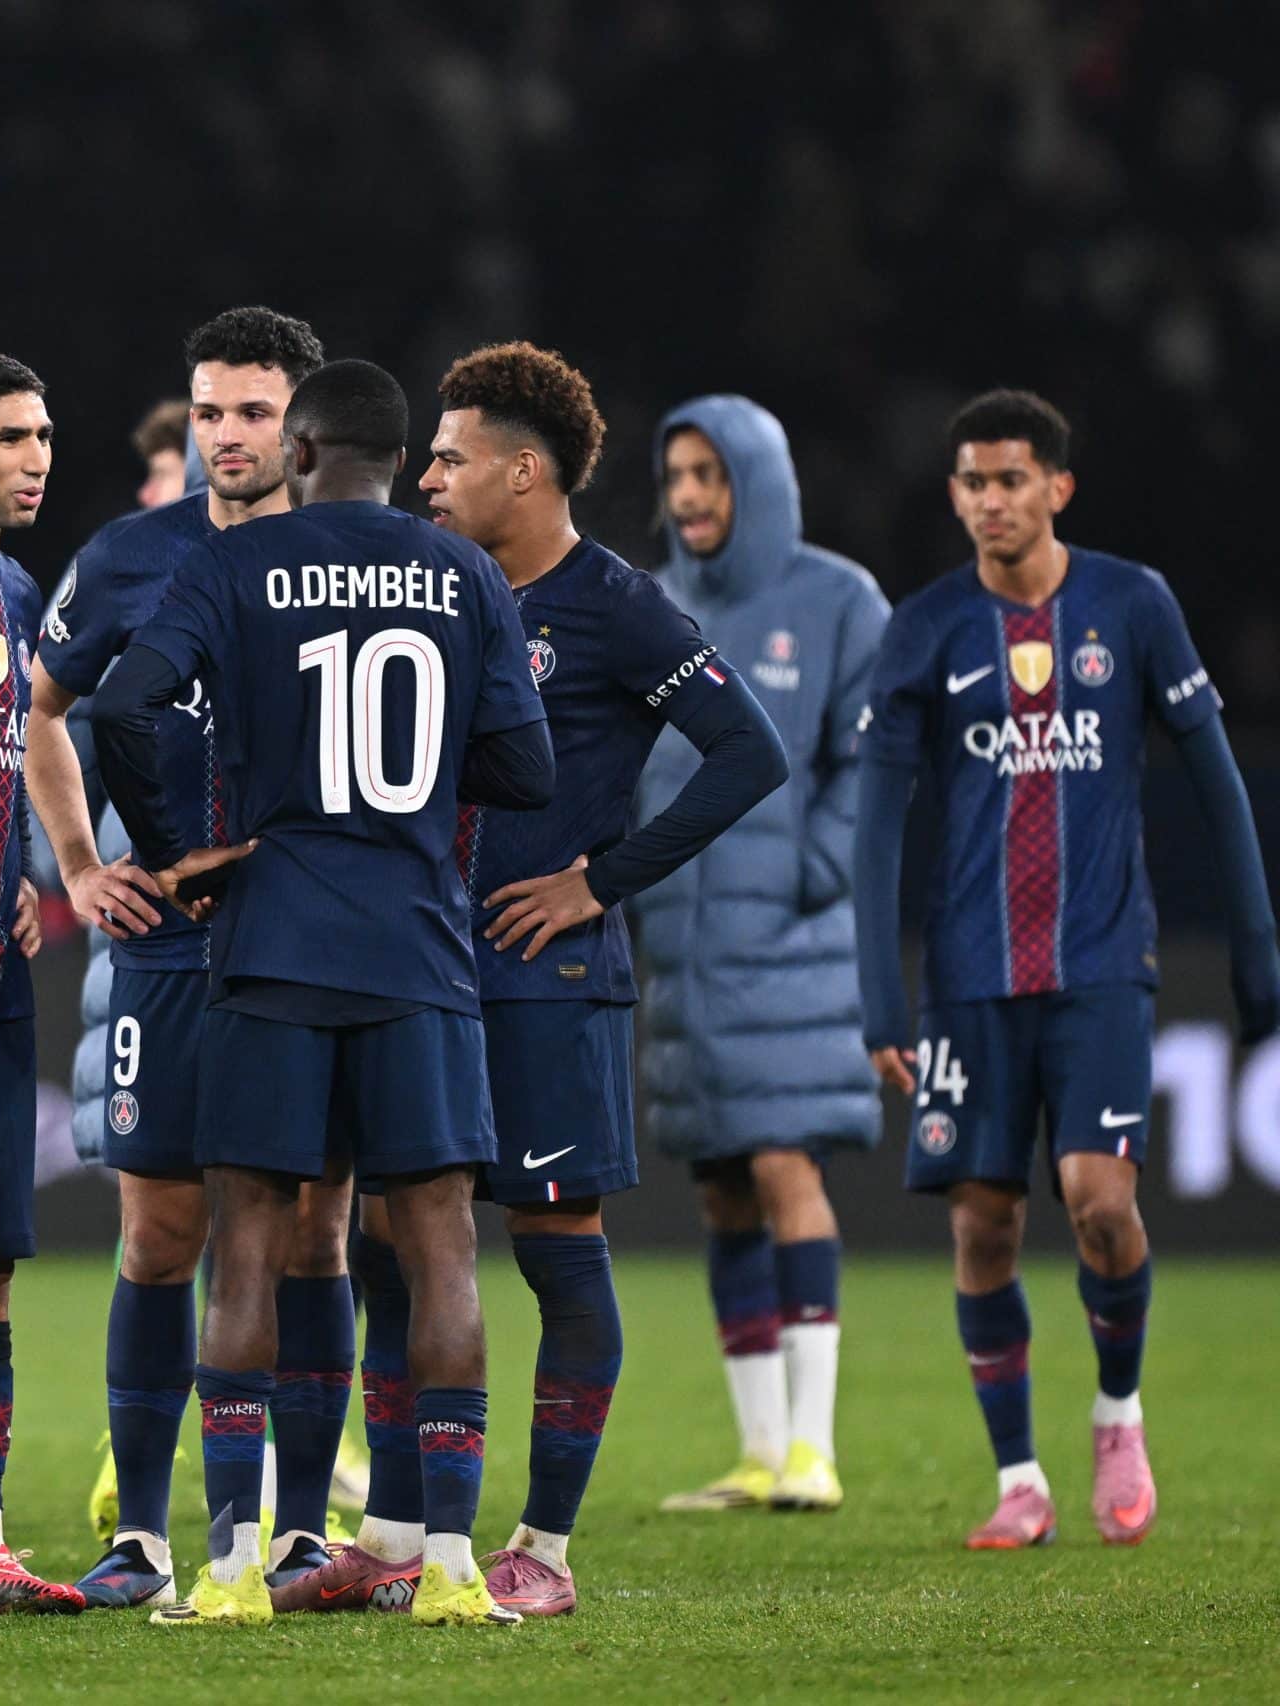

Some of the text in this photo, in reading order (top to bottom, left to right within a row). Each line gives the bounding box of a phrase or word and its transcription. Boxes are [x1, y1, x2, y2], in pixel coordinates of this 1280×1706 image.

[266, 561, 460, 617] O.DEMBÉLÉ
[299, 627, 446, 814] 10
[963, 709, 1103, 764] QATAR
[996, 747, 1104, 778] AIRWAYS
[113, 1015, 141, 1087] 9
[214, 1402, 262, 1417] PARIS
[419, 1421, 466, 1437] PARIS
